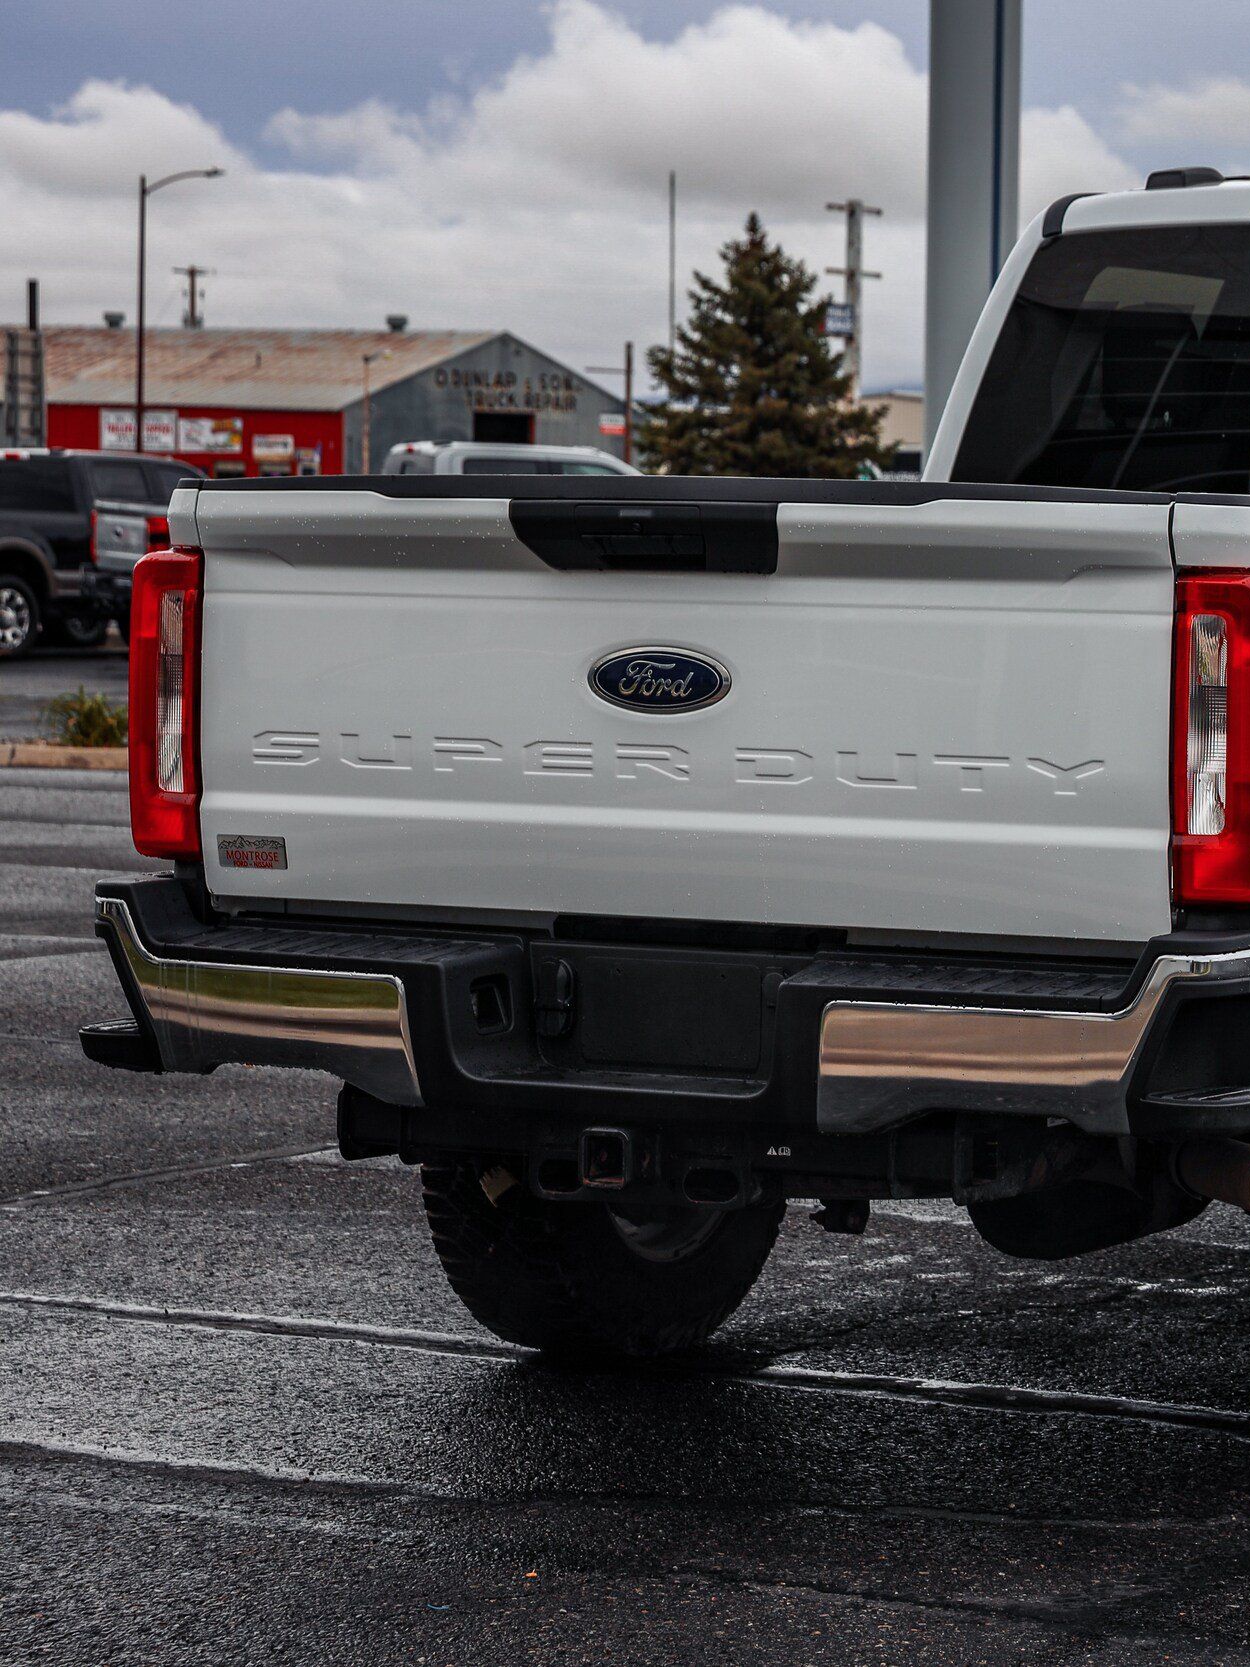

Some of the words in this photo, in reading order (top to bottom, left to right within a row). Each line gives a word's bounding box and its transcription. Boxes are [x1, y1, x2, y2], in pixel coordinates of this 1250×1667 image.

[465, 388, 519, 407] TRUCK
[524, 391, 578, 411] REPAIR
[619, 660, 694, 697] Ford
[253, 730, 690, 781] SUPER
[735, 746, 1105, 795] DUTY
[226, 849, 279, 862] MONTROSE
